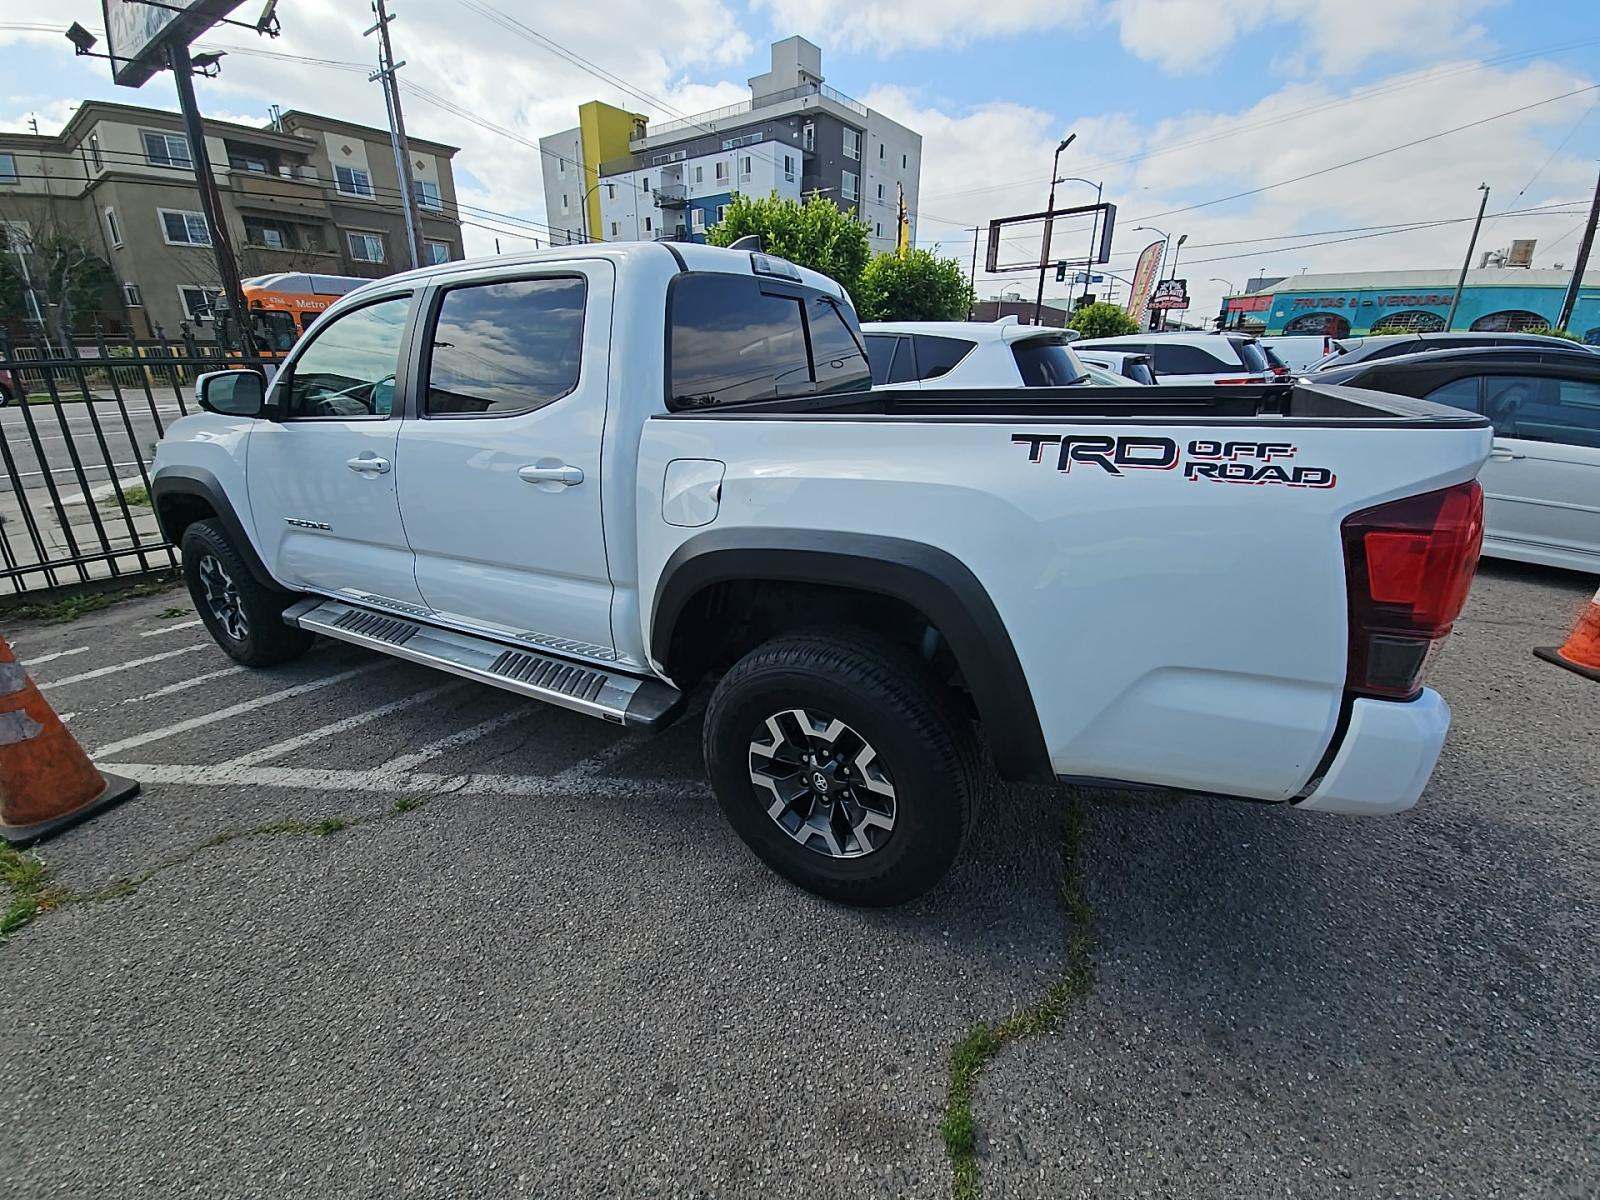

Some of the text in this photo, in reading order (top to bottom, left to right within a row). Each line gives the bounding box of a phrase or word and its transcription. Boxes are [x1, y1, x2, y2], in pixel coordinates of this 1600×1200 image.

[295, 299, 326, 309] Metro
[1293, 298, 1346, 309] FRUTAS
[1011, 434, 1180, 477] TRD
[1187, 440, 1297, 462] OFF
[1184, 462, 1336, 489] ROAD
